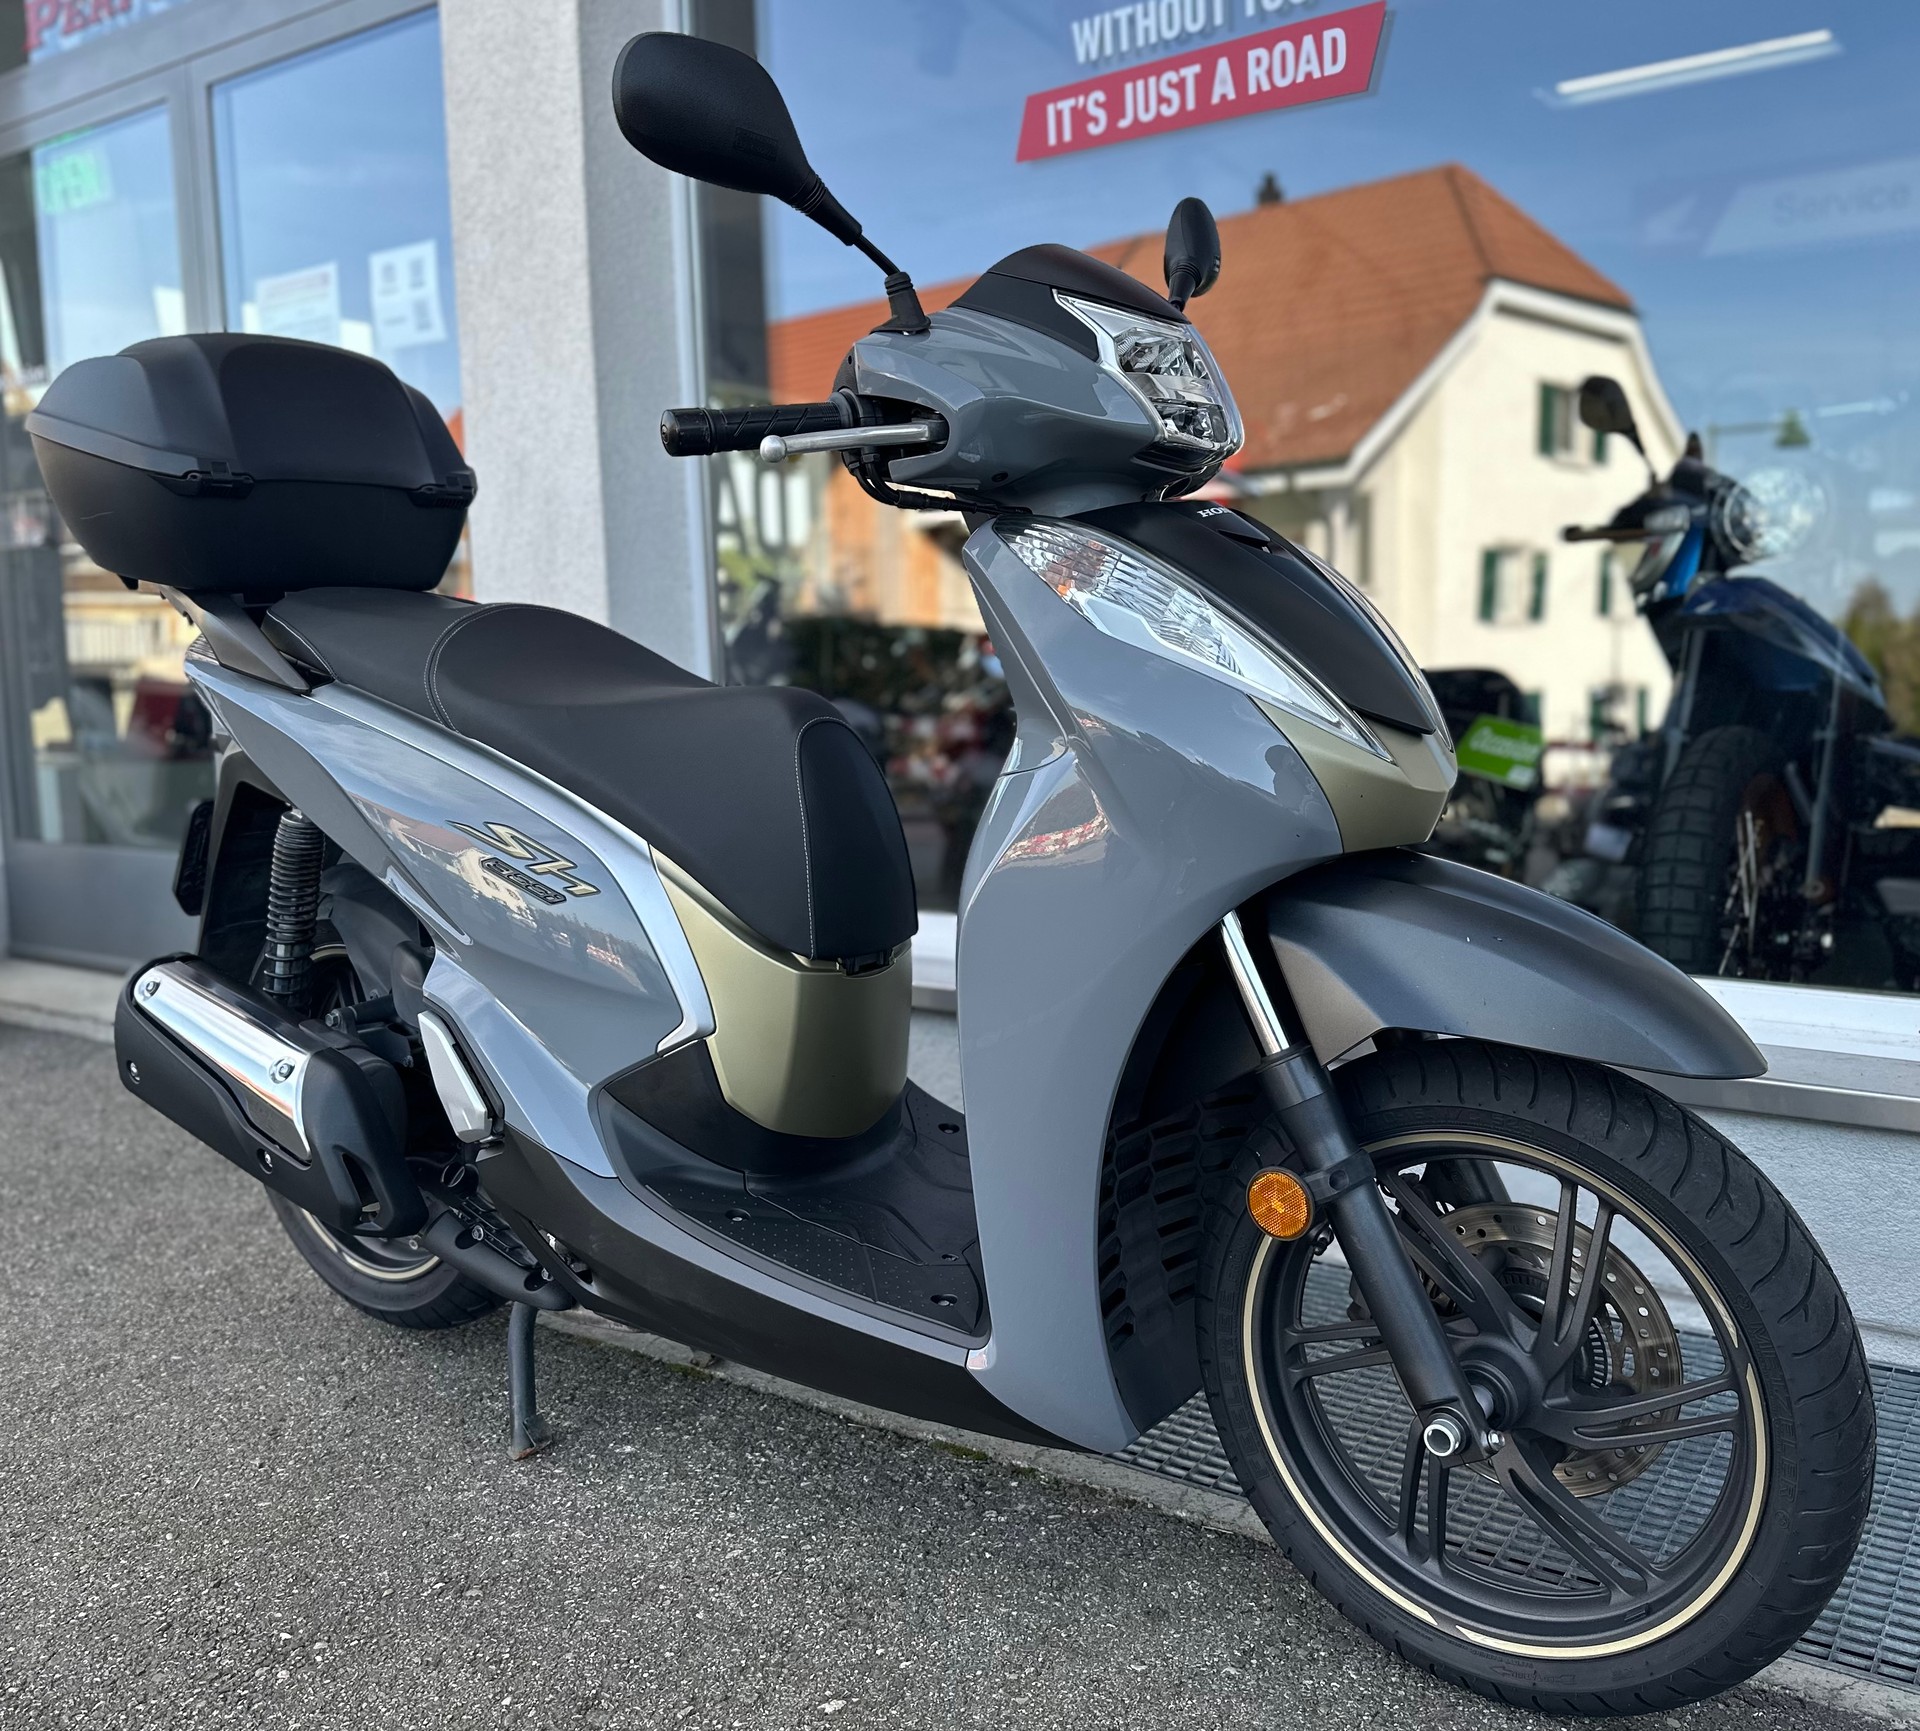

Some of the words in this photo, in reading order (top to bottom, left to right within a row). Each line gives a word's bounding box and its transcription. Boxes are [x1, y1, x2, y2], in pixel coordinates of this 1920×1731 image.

[1072, 0, 1226, 64] WITHOUT
[1046, 89, 1108, 147] IT'S
[1116, 64, 1202, 129] JUST
[1210, 56, 1237, 105] A
[1247, 27, 1347, 95] ROAD
[1772, 181, 1912, 228] Service
[1197, 507, 1232, 518] HON
